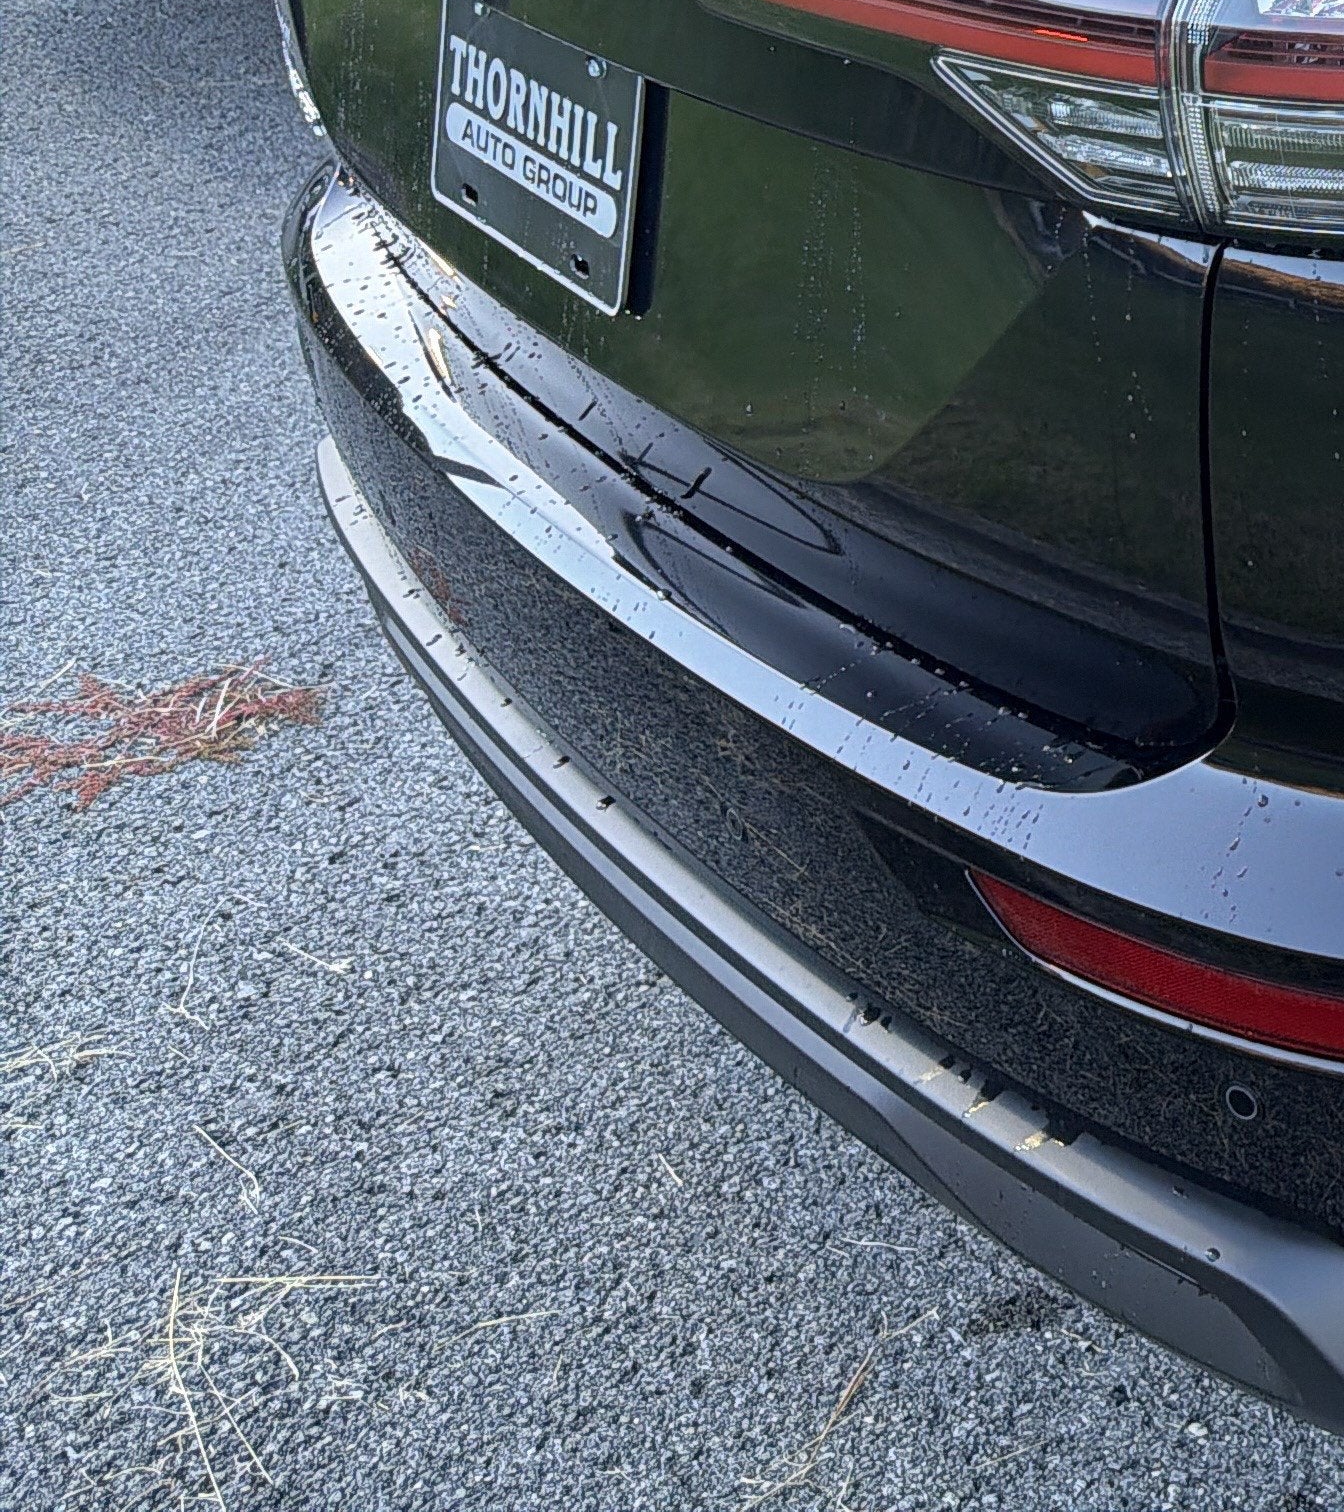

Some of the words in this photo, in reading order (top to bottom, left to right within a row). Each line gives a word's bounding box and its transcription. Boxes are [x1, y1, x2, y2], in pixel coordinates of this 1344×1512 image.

[449, 34, 623, 190] THORNHILL
[461, 118, 516, 168] AUTO
[522, 155, 598, 219] GROUP
